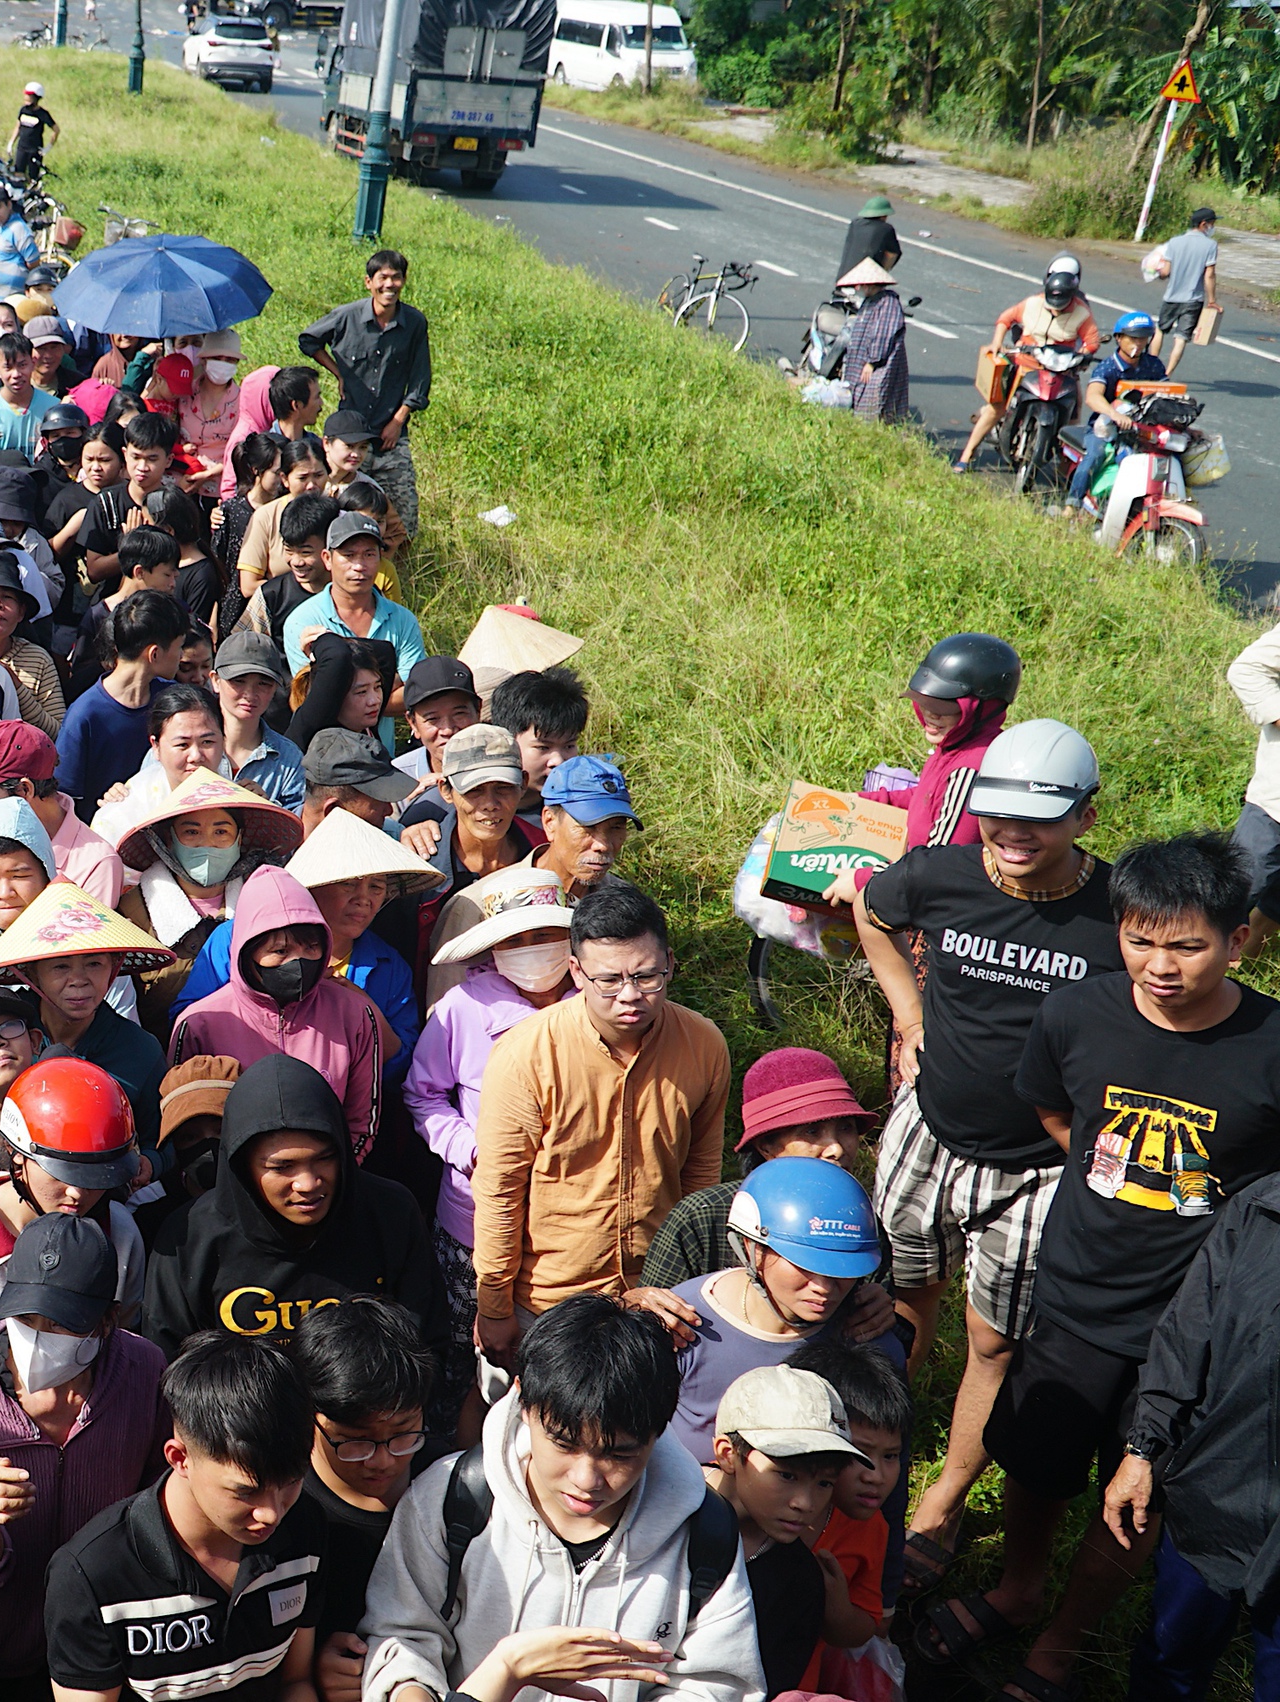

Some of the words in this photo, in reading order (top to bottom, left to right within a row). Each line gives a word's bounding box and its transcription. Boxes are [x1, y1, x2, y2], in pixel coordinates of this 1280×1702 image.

[941, 927, 1089, 982] BOULEVARD
[960, 964, 1052, 994] PARISPRANCE
[1108, 1091, 1214, 1128] FABULOUS
[823, 1219, 844, 1230] TTT
[278, 1595, 302, 1612] DIOR
[125, 1613, 215, 1657] DIOR
